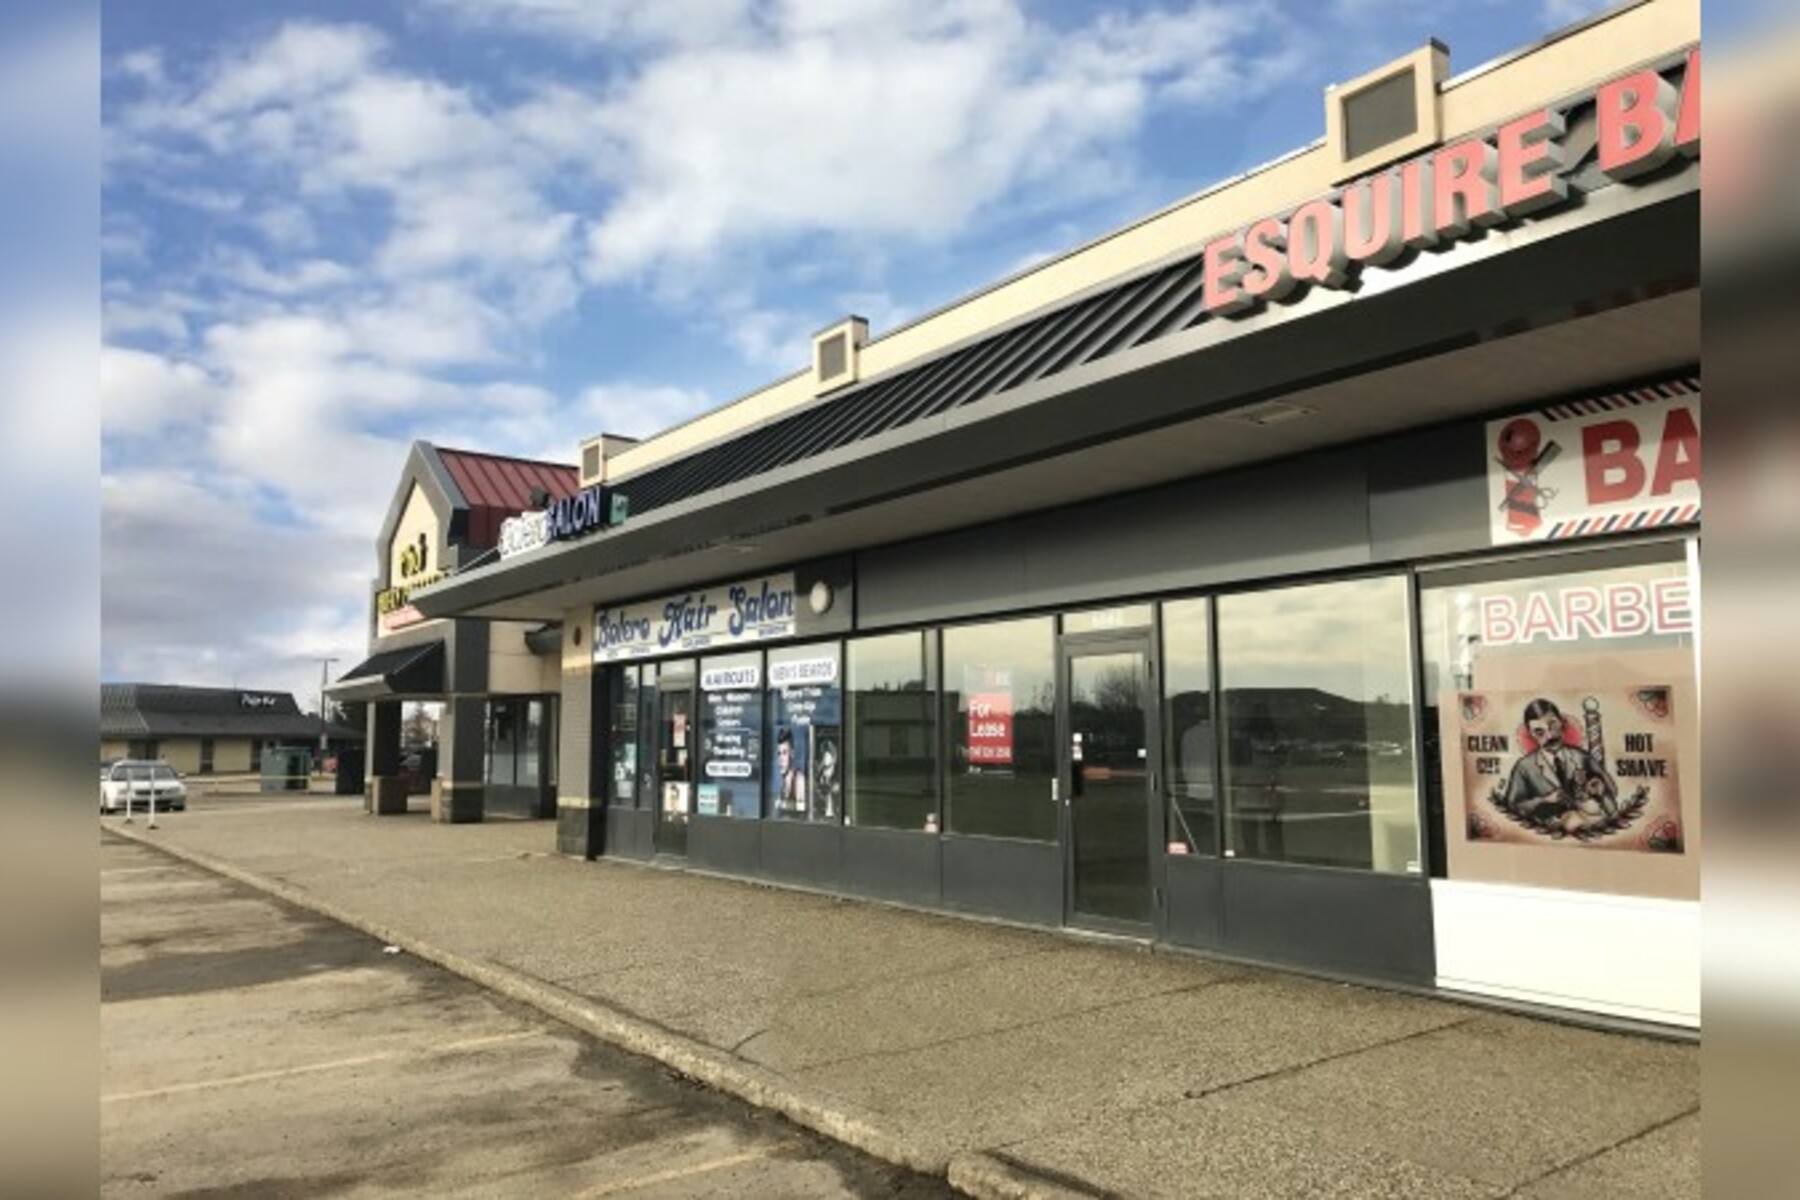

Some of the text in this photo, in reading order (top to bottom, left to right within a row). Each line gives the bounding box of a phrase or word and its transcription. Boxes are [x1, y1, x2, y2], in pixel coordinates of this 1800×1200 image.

[1202, 108, 1560, 314] ESQUIRE
[594, 581, 795, 651] Bolero Hair Salon
[1481, 578, 1692, 645] BARBE
[969, 699, 991, 718] For
[969, 719, 1006, 737] Lease
[1467, 735, 1509, 752] CLEAN
[1624, 733, 1654, 752] HOT
[1476, 757, 1501, 774] CUT
[1615, 759, 1669, 777] SHAVE
